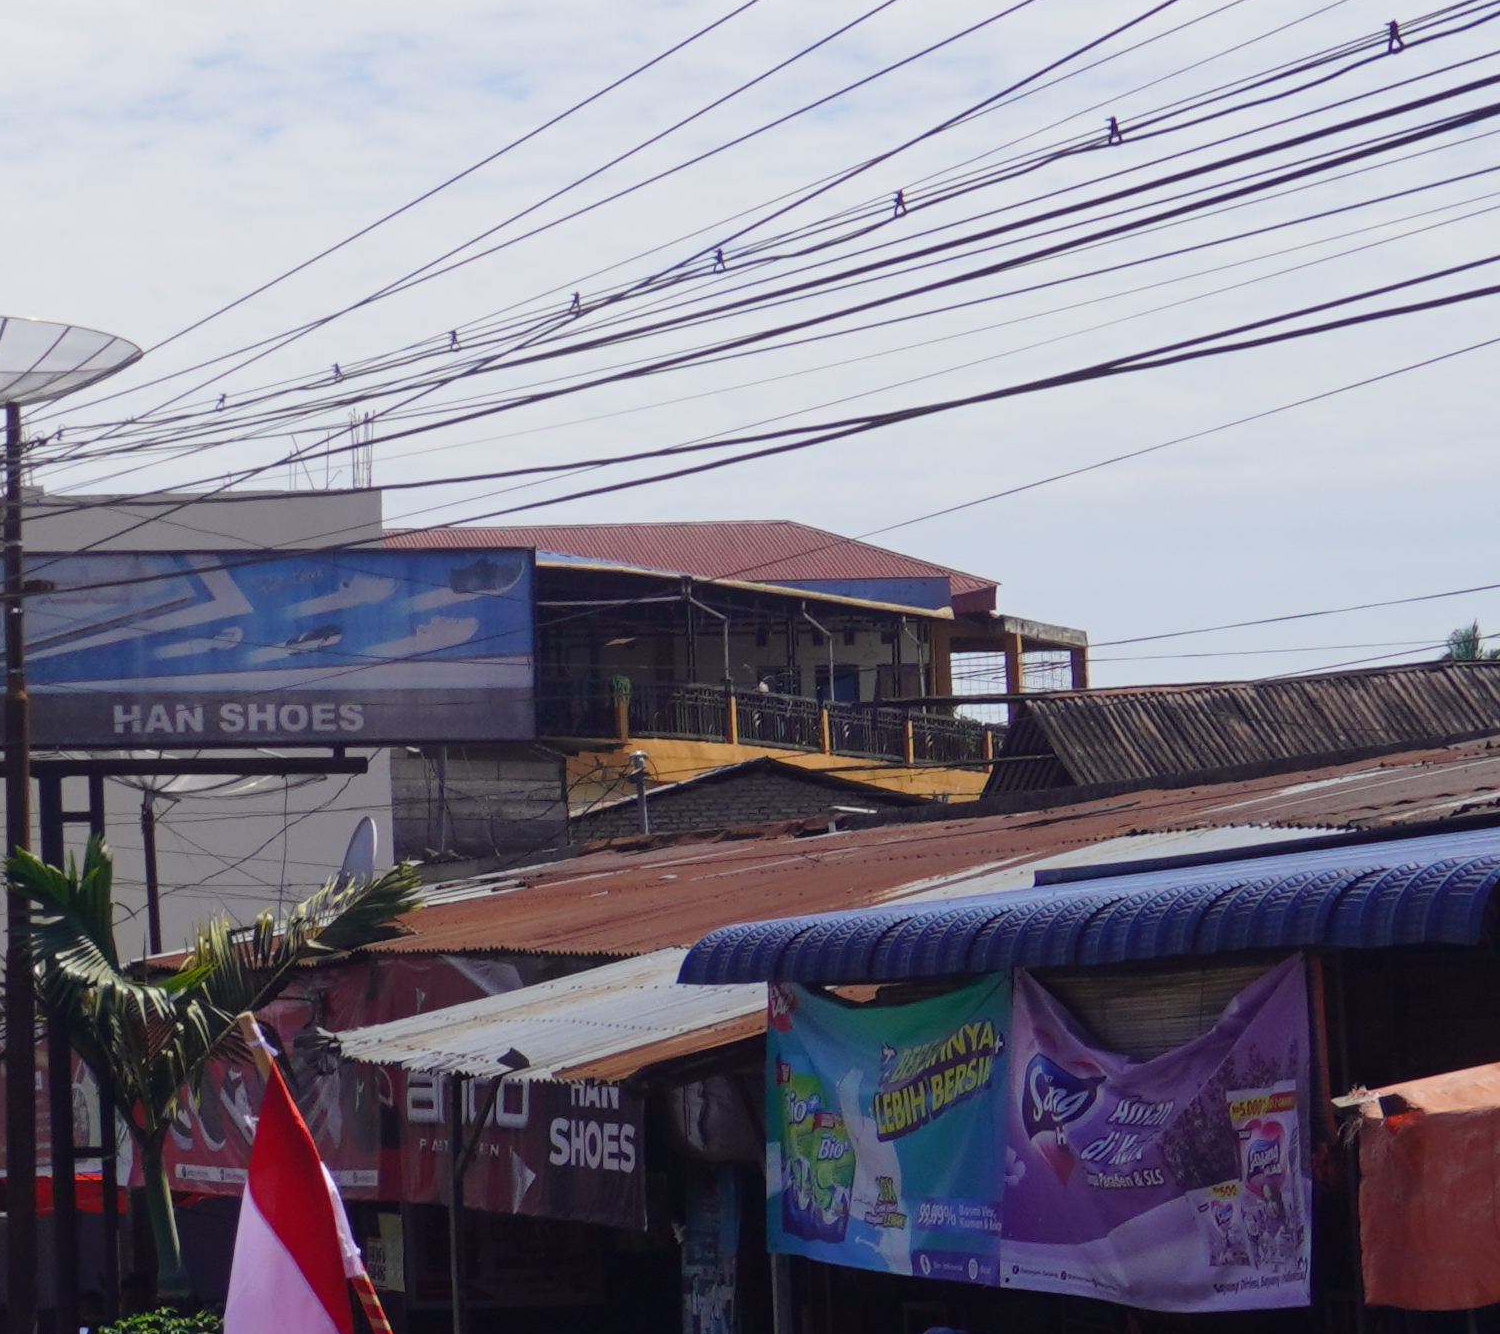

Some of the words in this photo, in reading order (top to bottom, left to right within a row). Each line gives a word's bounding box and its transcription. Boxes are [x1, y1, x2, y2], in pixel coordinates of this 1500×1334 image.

[113, 703, 203, 734] HAN
[219, 702, 365, 733] SHOES
[570, 1083, 620, 1110] HAN
[875, 1080, 927, 1135] LEBIH
[549, 1116, 637, 1174] SHOES
[1143, 1168, 1165, 1185] SLS
